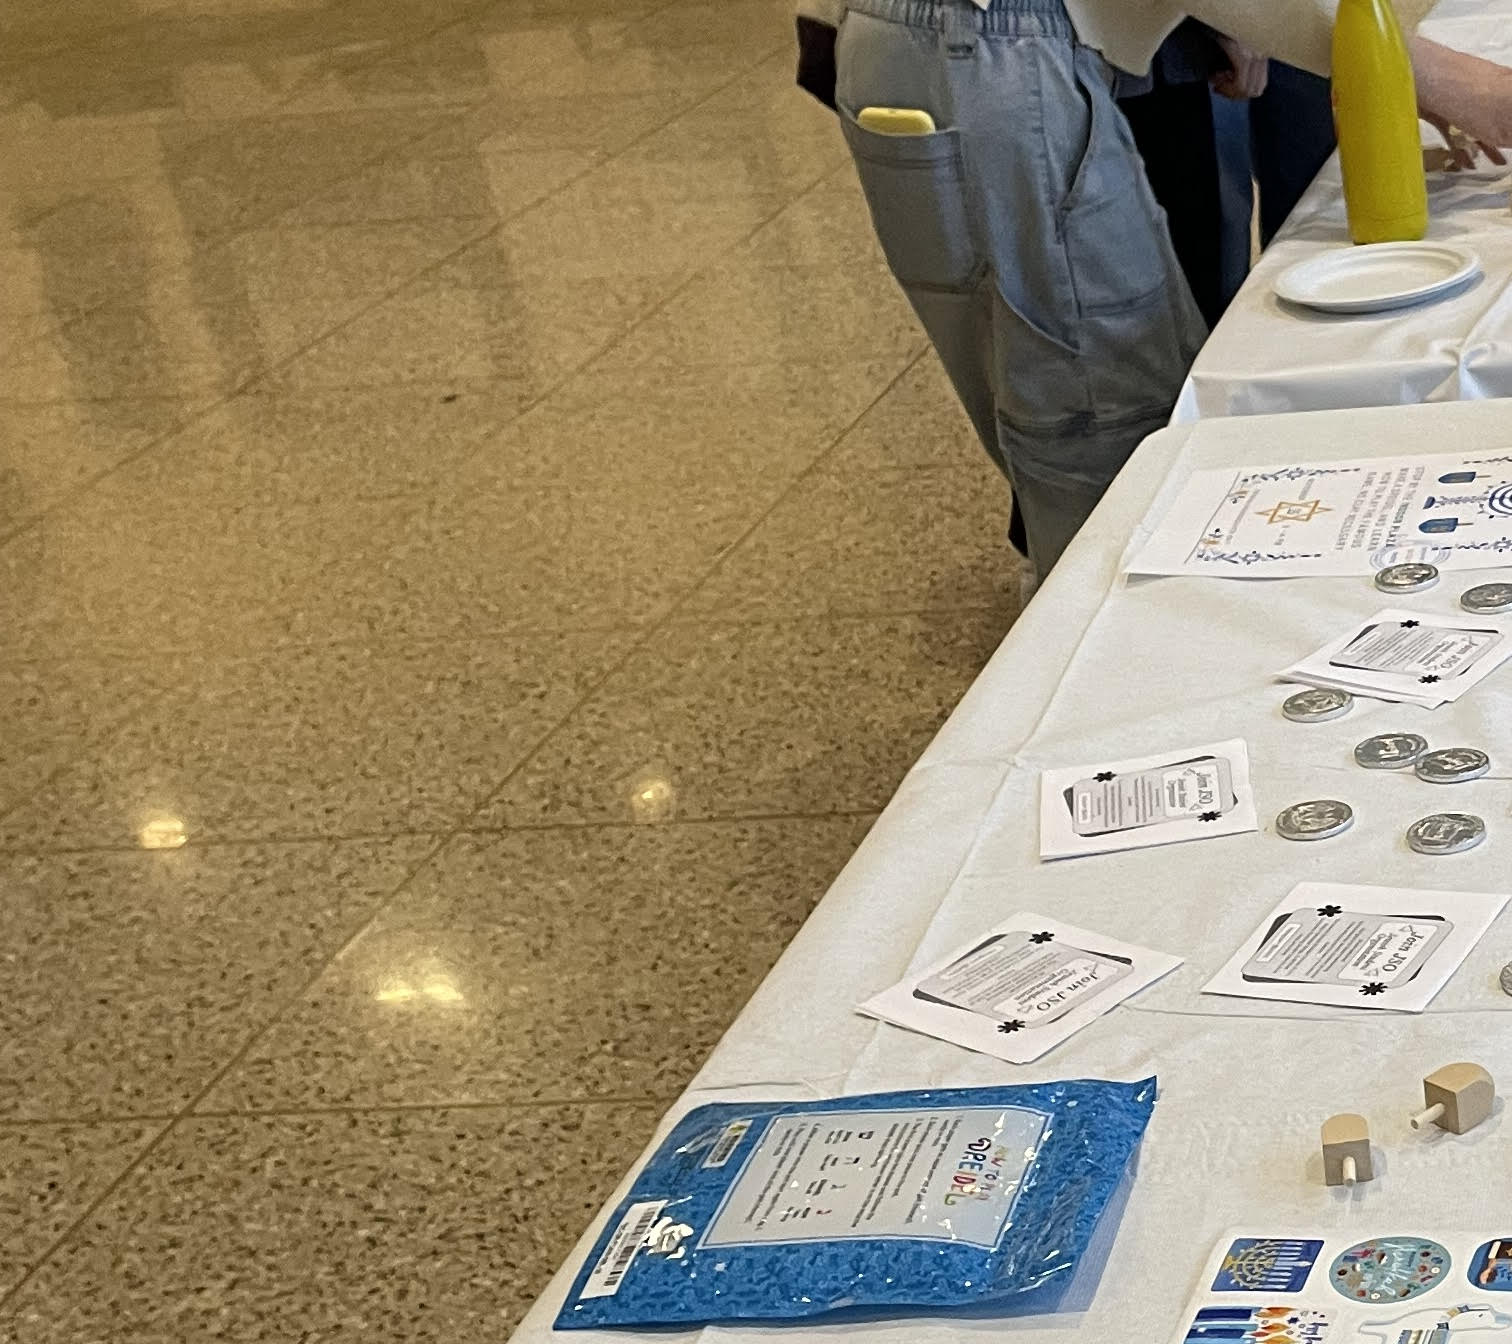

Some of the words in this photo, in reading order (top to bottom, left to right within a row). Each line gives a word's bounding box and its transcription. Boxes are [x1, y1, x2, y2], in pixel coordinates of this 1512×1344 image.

[1382, 953, 1408, 972] JSO
[1070, 971, 1099, 991] Join
[1037, 991, 1070, 1012] JSO
[944, 1137, 992, 1206] DREIDEL
